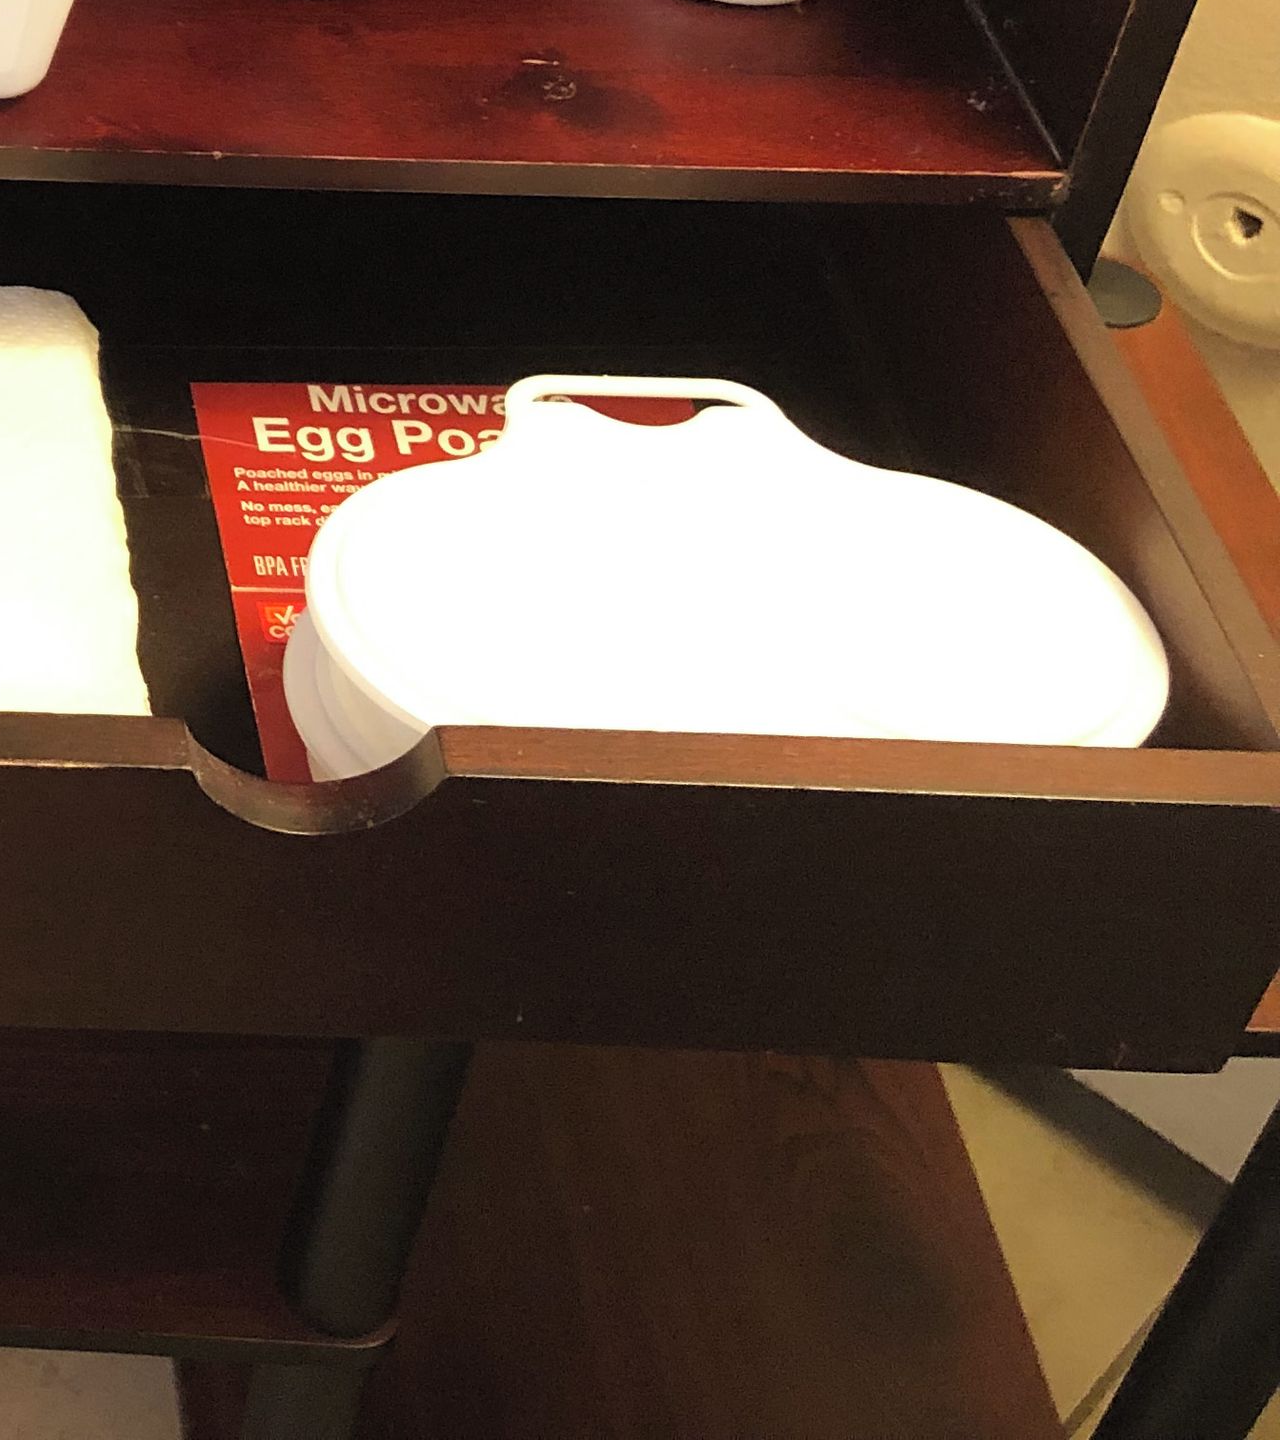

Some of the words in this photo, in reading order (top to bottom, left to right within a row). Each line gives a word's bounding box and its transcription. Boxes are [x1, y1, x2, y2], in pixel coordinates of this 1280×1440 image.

[251, 416, 375, 462] Egg
[233, 467, 309, 480] Poached
[312, 470, 354, 482] eggs
[357, 468, 374, 480] in
[237, 479, 251, 492] A
[253, 480, 327, 493] healthier
[240, 500, 265, 512] No
[268, 503, 317, 514] mess,
[243, 514, 272, 527] top
[274, 515, 312, 526] rack
[252, 554, 289, 577] BPA
